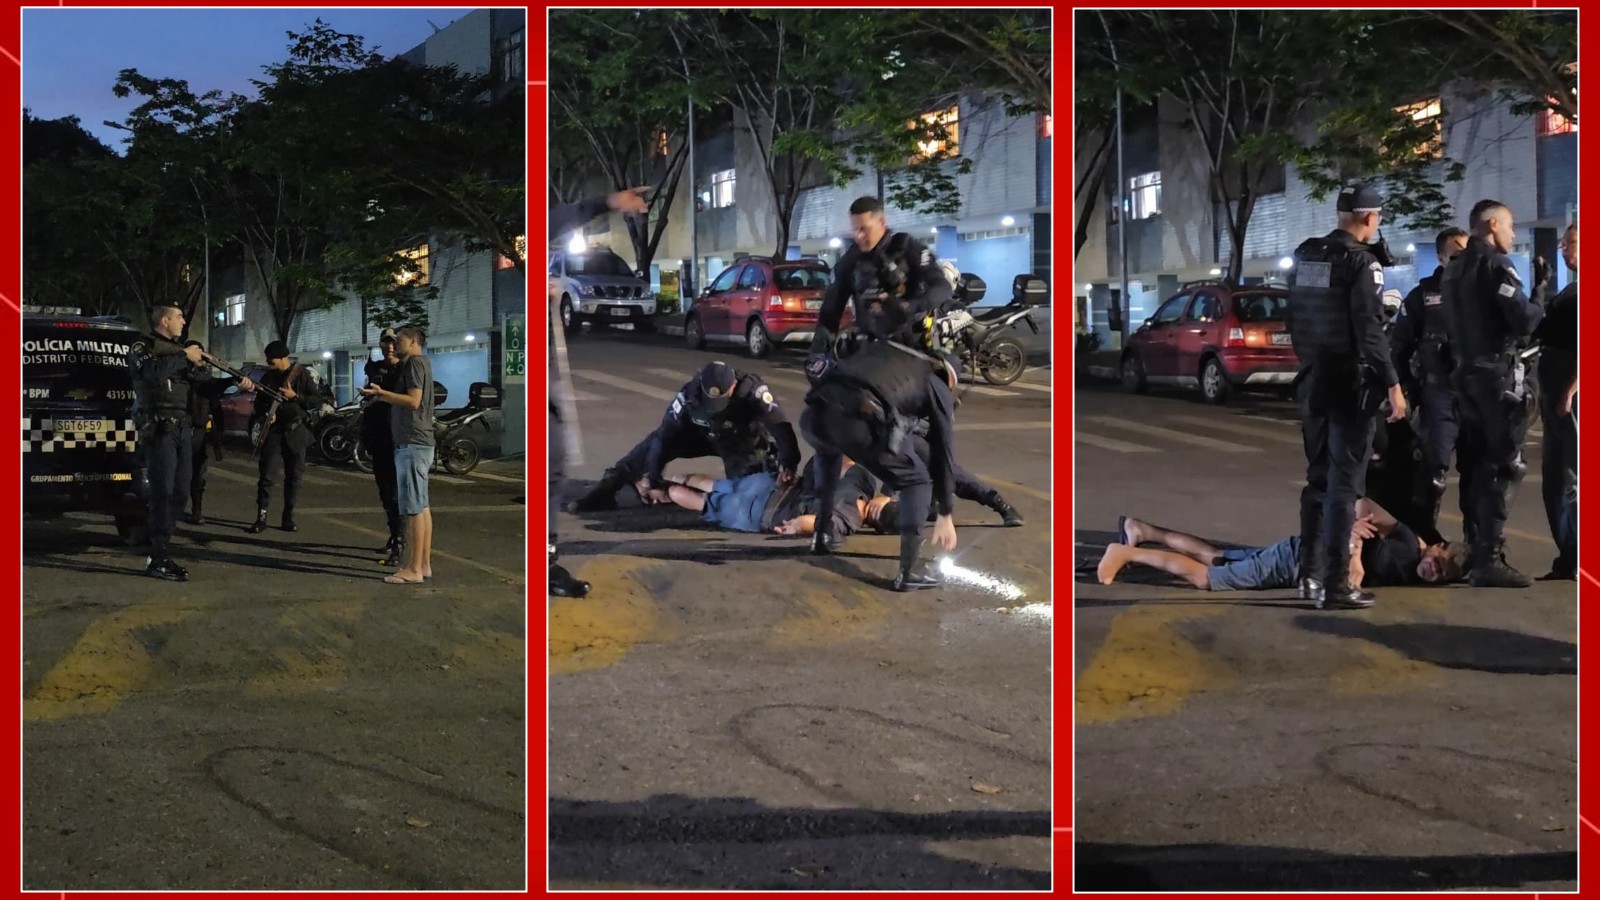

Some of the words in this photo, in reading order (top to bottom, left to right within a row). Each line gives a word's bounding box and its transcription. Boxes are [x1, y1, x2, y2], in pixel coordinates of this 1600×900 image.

[23, 338, 74, 352] OLÍCIA
[23, 354, 77, 365] DISTRITO
[81, 354, 129, 367] FEDERAL
[506, 352, 514, 363] N
[29, 388, 49, 398] BPM
[106, 390, 126, 400] 4315
[57, 420, 102, 431] SGT6F59
[30, 474, 73, 483] GRUPAMENTO
